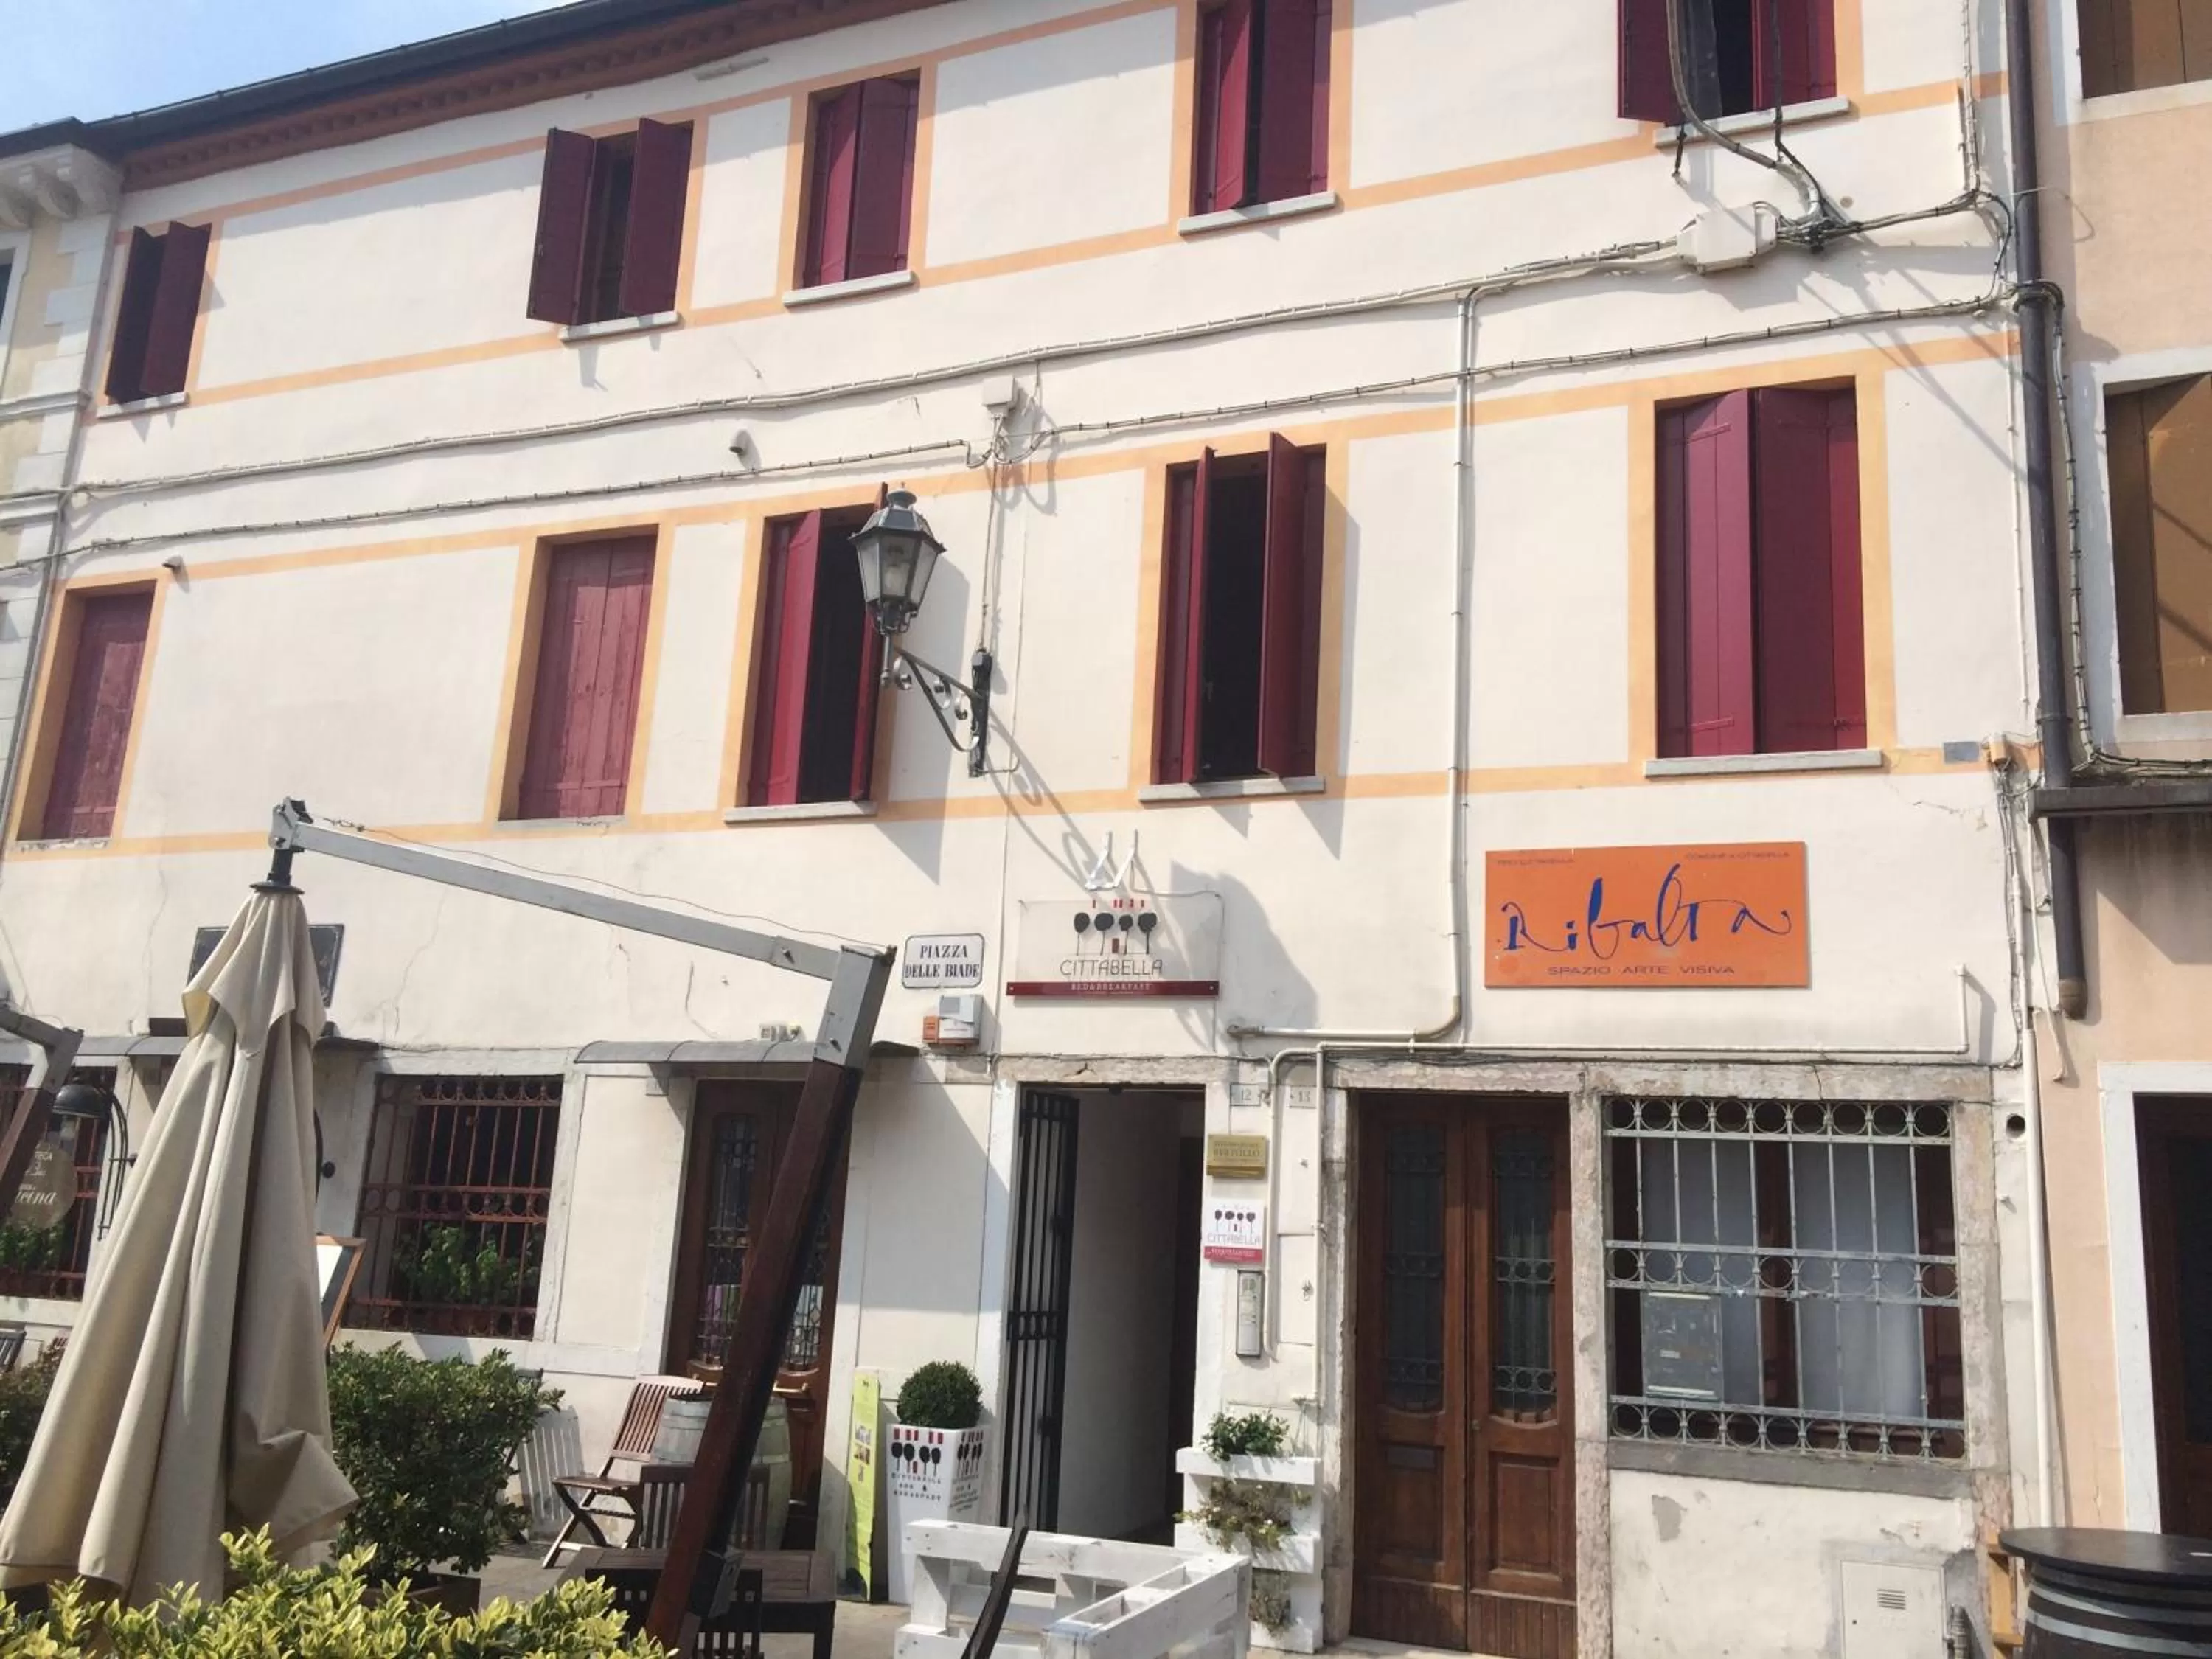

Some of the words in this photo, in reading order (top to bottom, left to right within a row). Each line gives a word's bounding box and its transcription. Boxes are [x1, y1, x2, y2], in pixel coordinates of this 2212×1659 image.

[919, 945, 968, 959] PIAZZA
[904, 964, 941, 978] DELLE
[945, 964, 980, 978] BIADE
[1060, 959, 1164, 976] CITTABELLA
[1548, 966, 1612, 976] SPAZIO
[1622, 965, 1669, 975] ARTE
[1680, 965, 1736, 975] VISIVA
